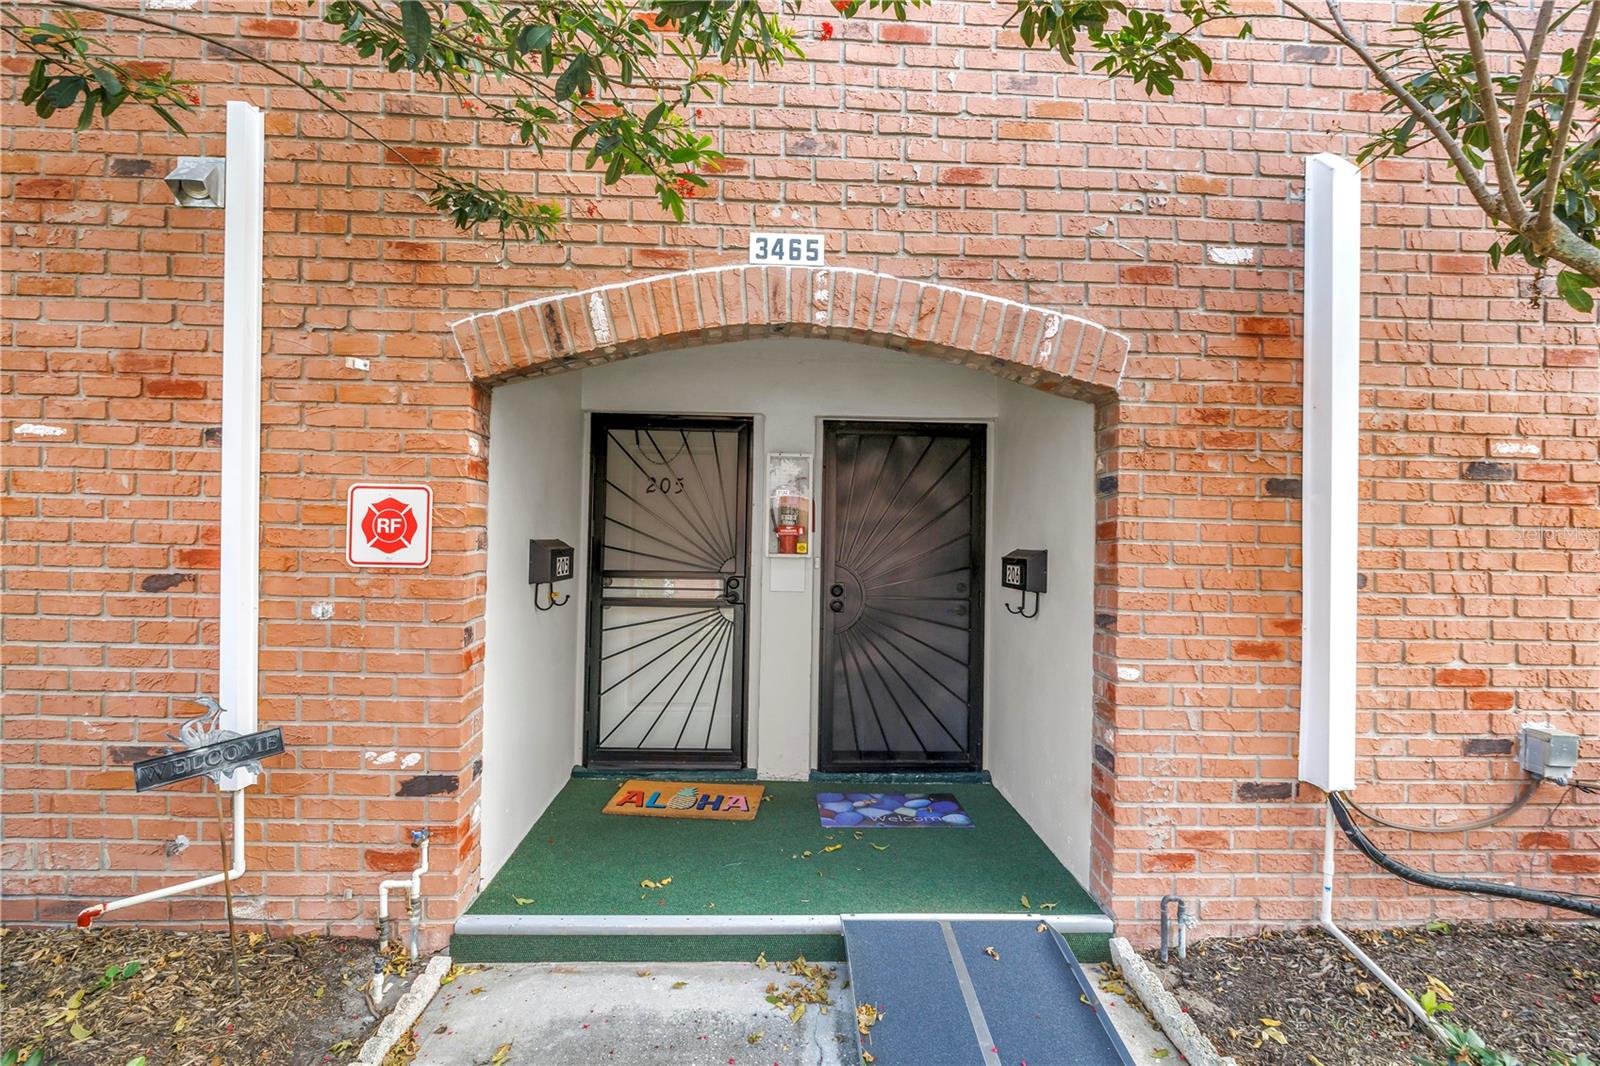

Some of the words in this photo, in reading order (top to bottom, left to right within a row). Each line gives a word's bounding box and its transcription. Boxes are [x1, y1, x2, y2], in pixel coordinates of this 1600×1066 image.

[755, 237, 819, 261] 3465
[646, 477, 684, 494] 205
[376, 518, 402, 534] RF
[557, 557, 569, 576] 205
[1007, 565, 1020, 585] 206
[138, 734, 279, 783] WELCOME
[616, 790, 750, 812] ALOHA
[869, 815, 953, 823] Welcom
